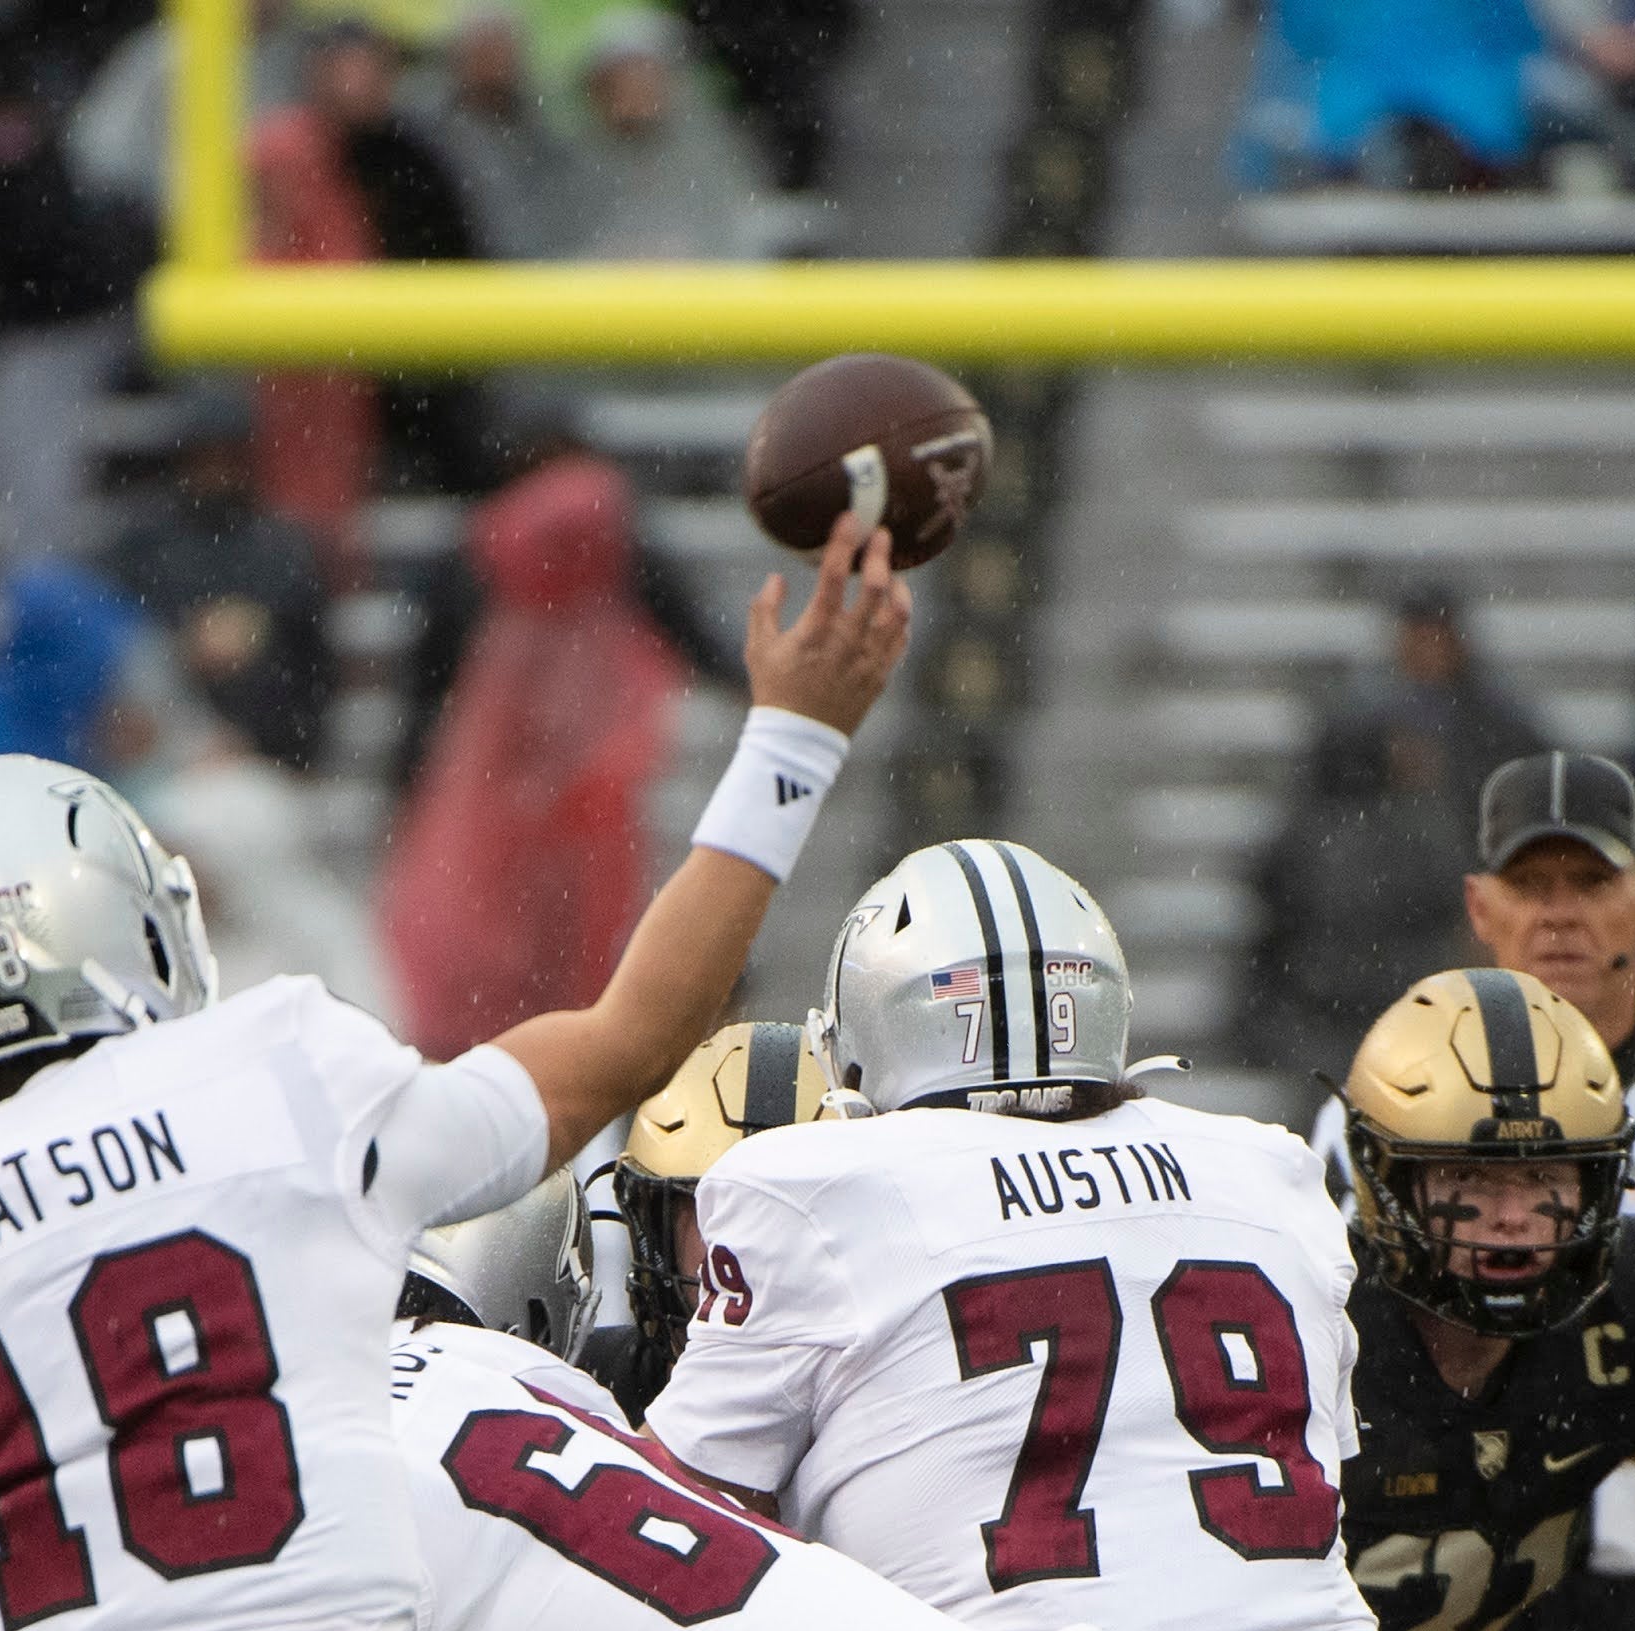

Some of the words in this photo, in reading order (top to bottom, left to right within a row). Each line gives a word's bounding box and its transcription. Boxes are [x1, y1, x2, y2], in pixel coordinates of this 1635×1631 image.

[1046, 960, 1094, 989] SBC
[968, 1086, 1074, 1119] TROJANS
[1497, 1119, 1545, 1140] ARMY
[989, 1140, 1195, 1221] AUSTIN
[1581, 1322, 1631, 1386] C
[943, 1253, 1343, 1594] 79
